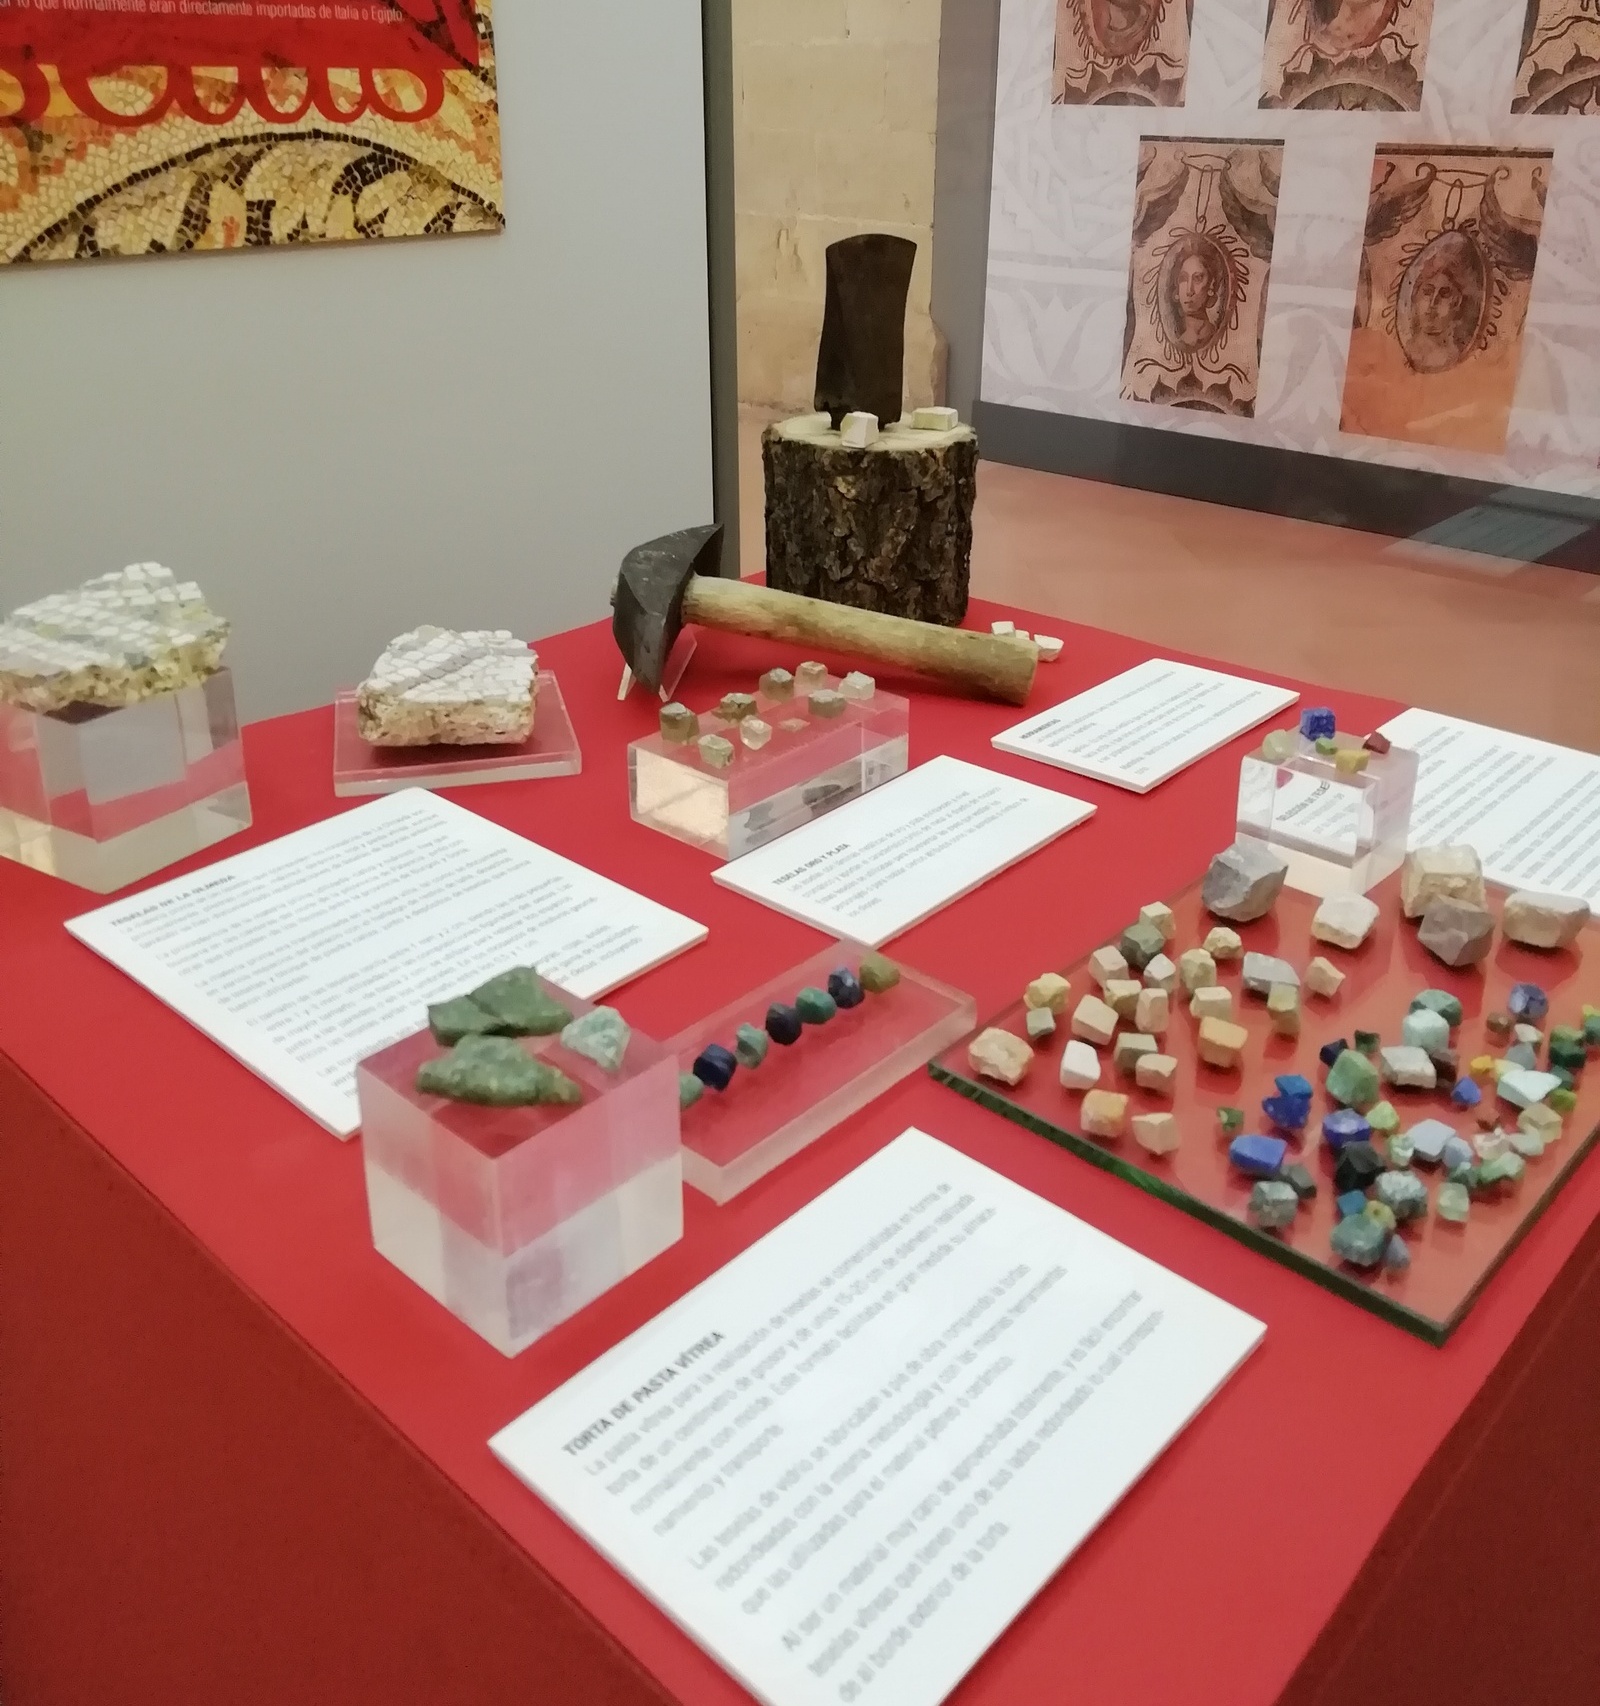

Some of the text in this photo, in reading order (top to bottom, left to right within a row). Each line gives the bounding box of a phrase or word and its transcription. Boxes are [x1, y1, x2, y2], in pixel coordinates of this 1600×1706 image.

[35, 0, 59, 11] que
[63, 0, 146, 12] normalmente
[150, 2, 176, 13] eran
[180, 0, 252, 16] directamente
[257, 3, 315, 19] importadas
[319, 8, 332, 19] de
[335, 6, 359, 20] Italia
[362, 10, 369, 20] o
[826, 844, 849, 855] PLATA
[563, 1332, 724, 1454] TORTA DE PASTA VÍTREA
